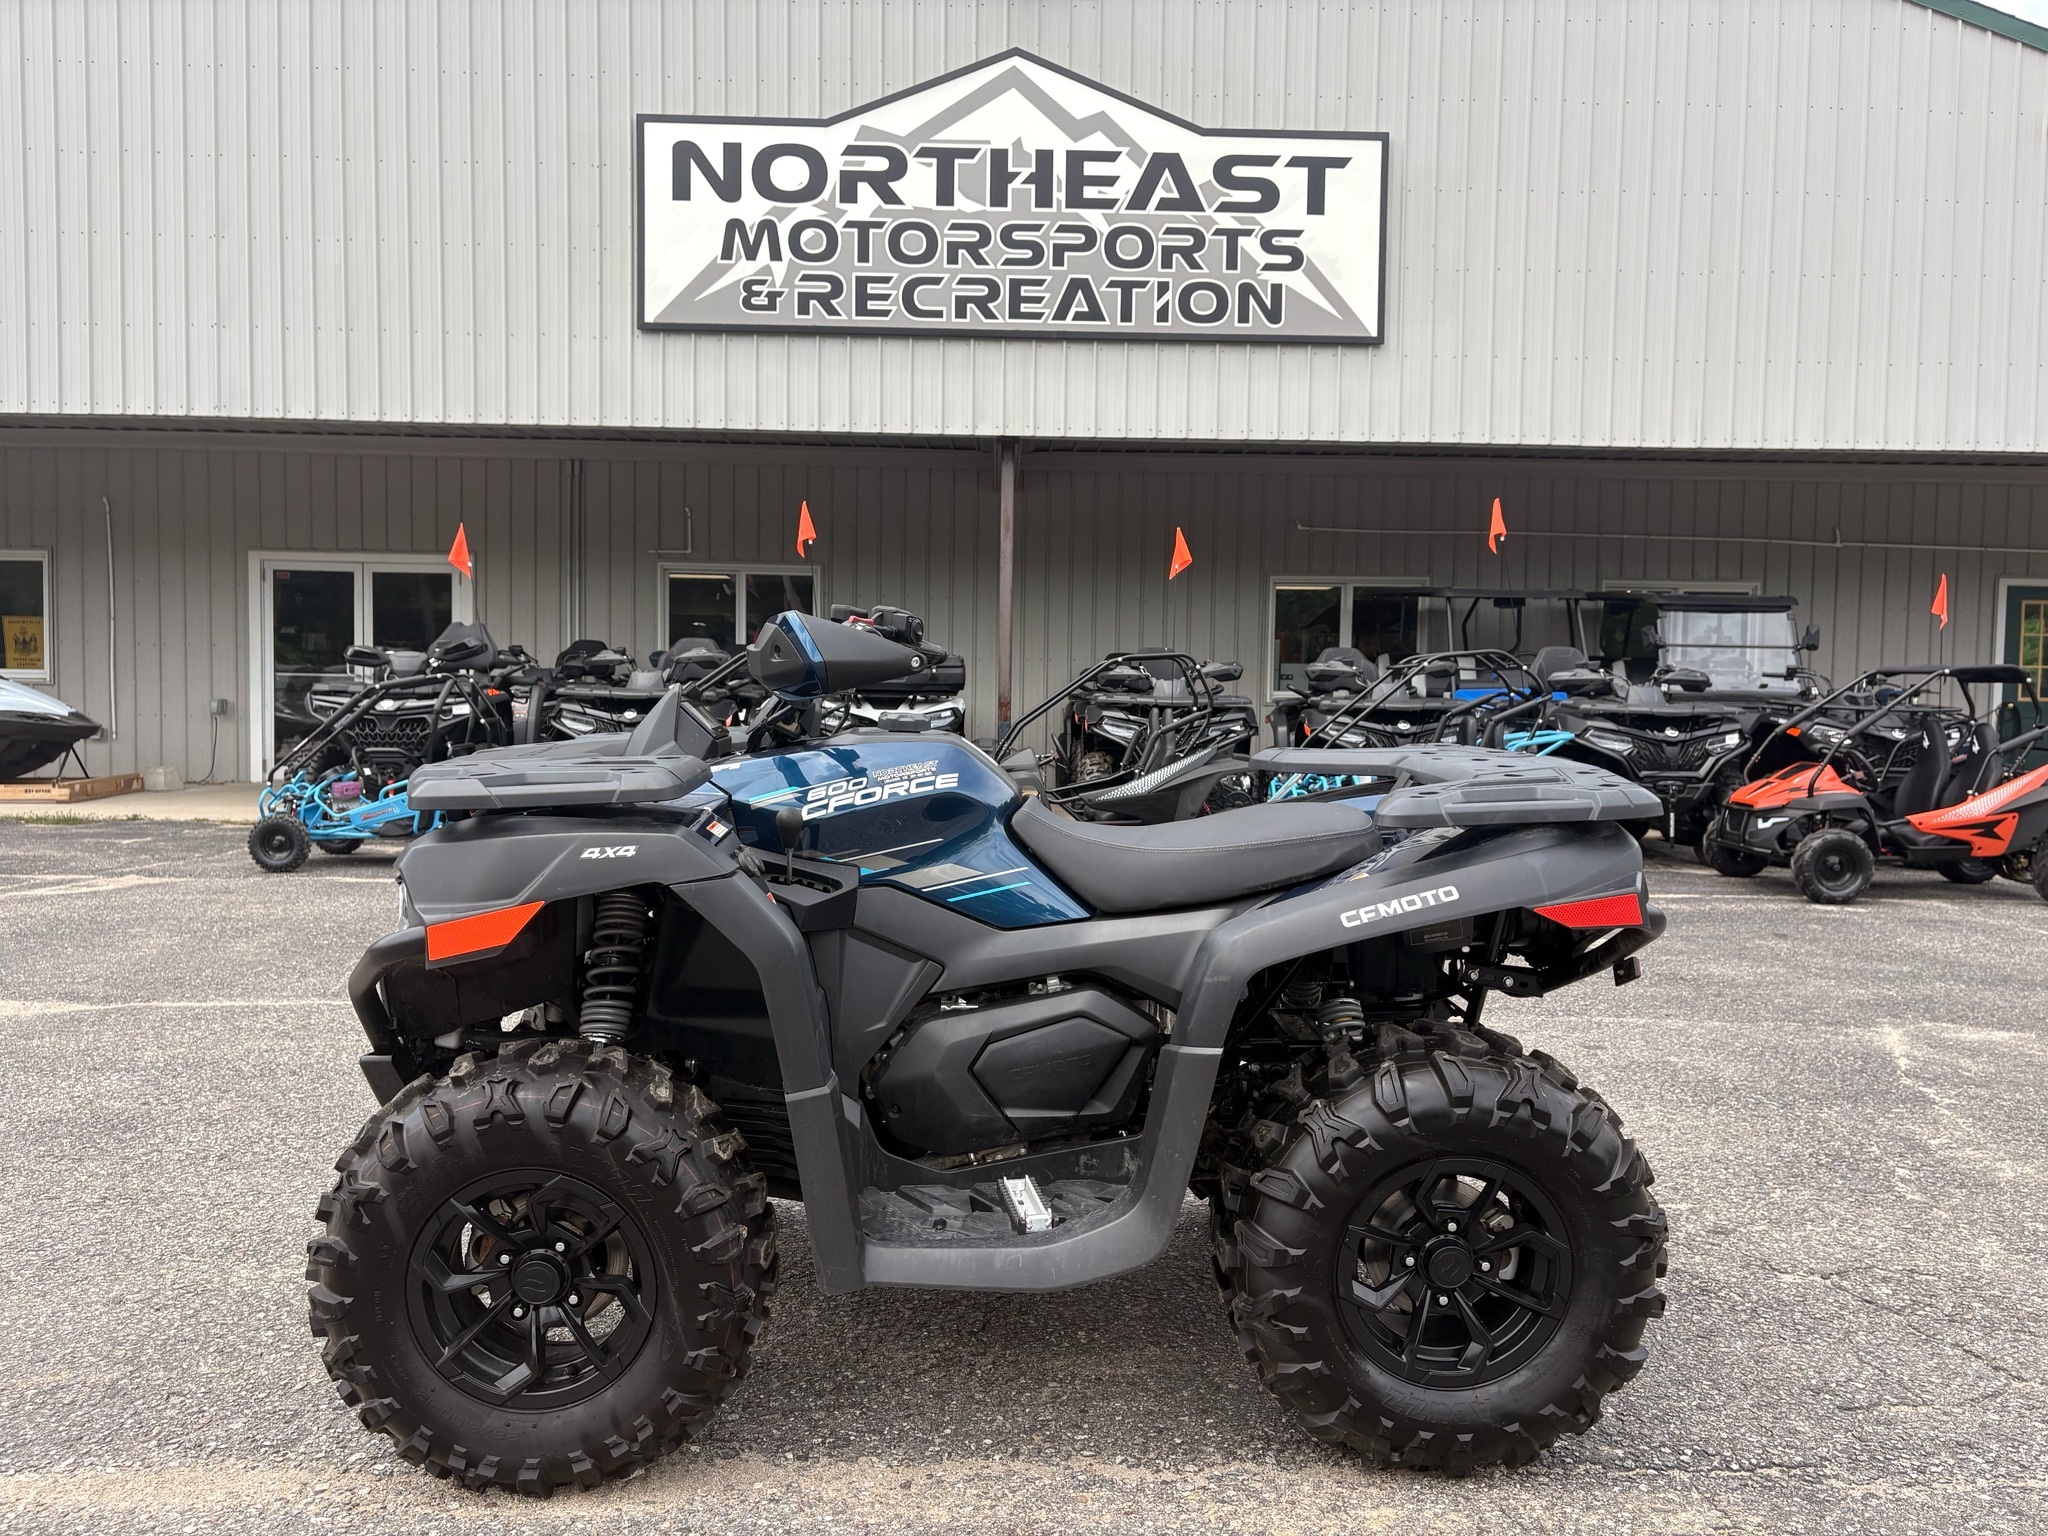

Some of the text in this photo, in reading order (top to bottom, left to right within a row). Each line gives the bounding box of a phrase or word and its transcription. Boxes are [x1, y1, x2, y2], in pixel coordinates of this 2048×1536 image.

[672, 139, 1353, 216] NORTHEAST
[720, 218, 1305, 273] MOTORSPORTS
[742, 273, 1283, 326] & RECREATION
[801, 773, 959, 822] CFORCE
[807, 777, 868, 802] 600
[1340, 885, 1460, 928] CFMOTO
